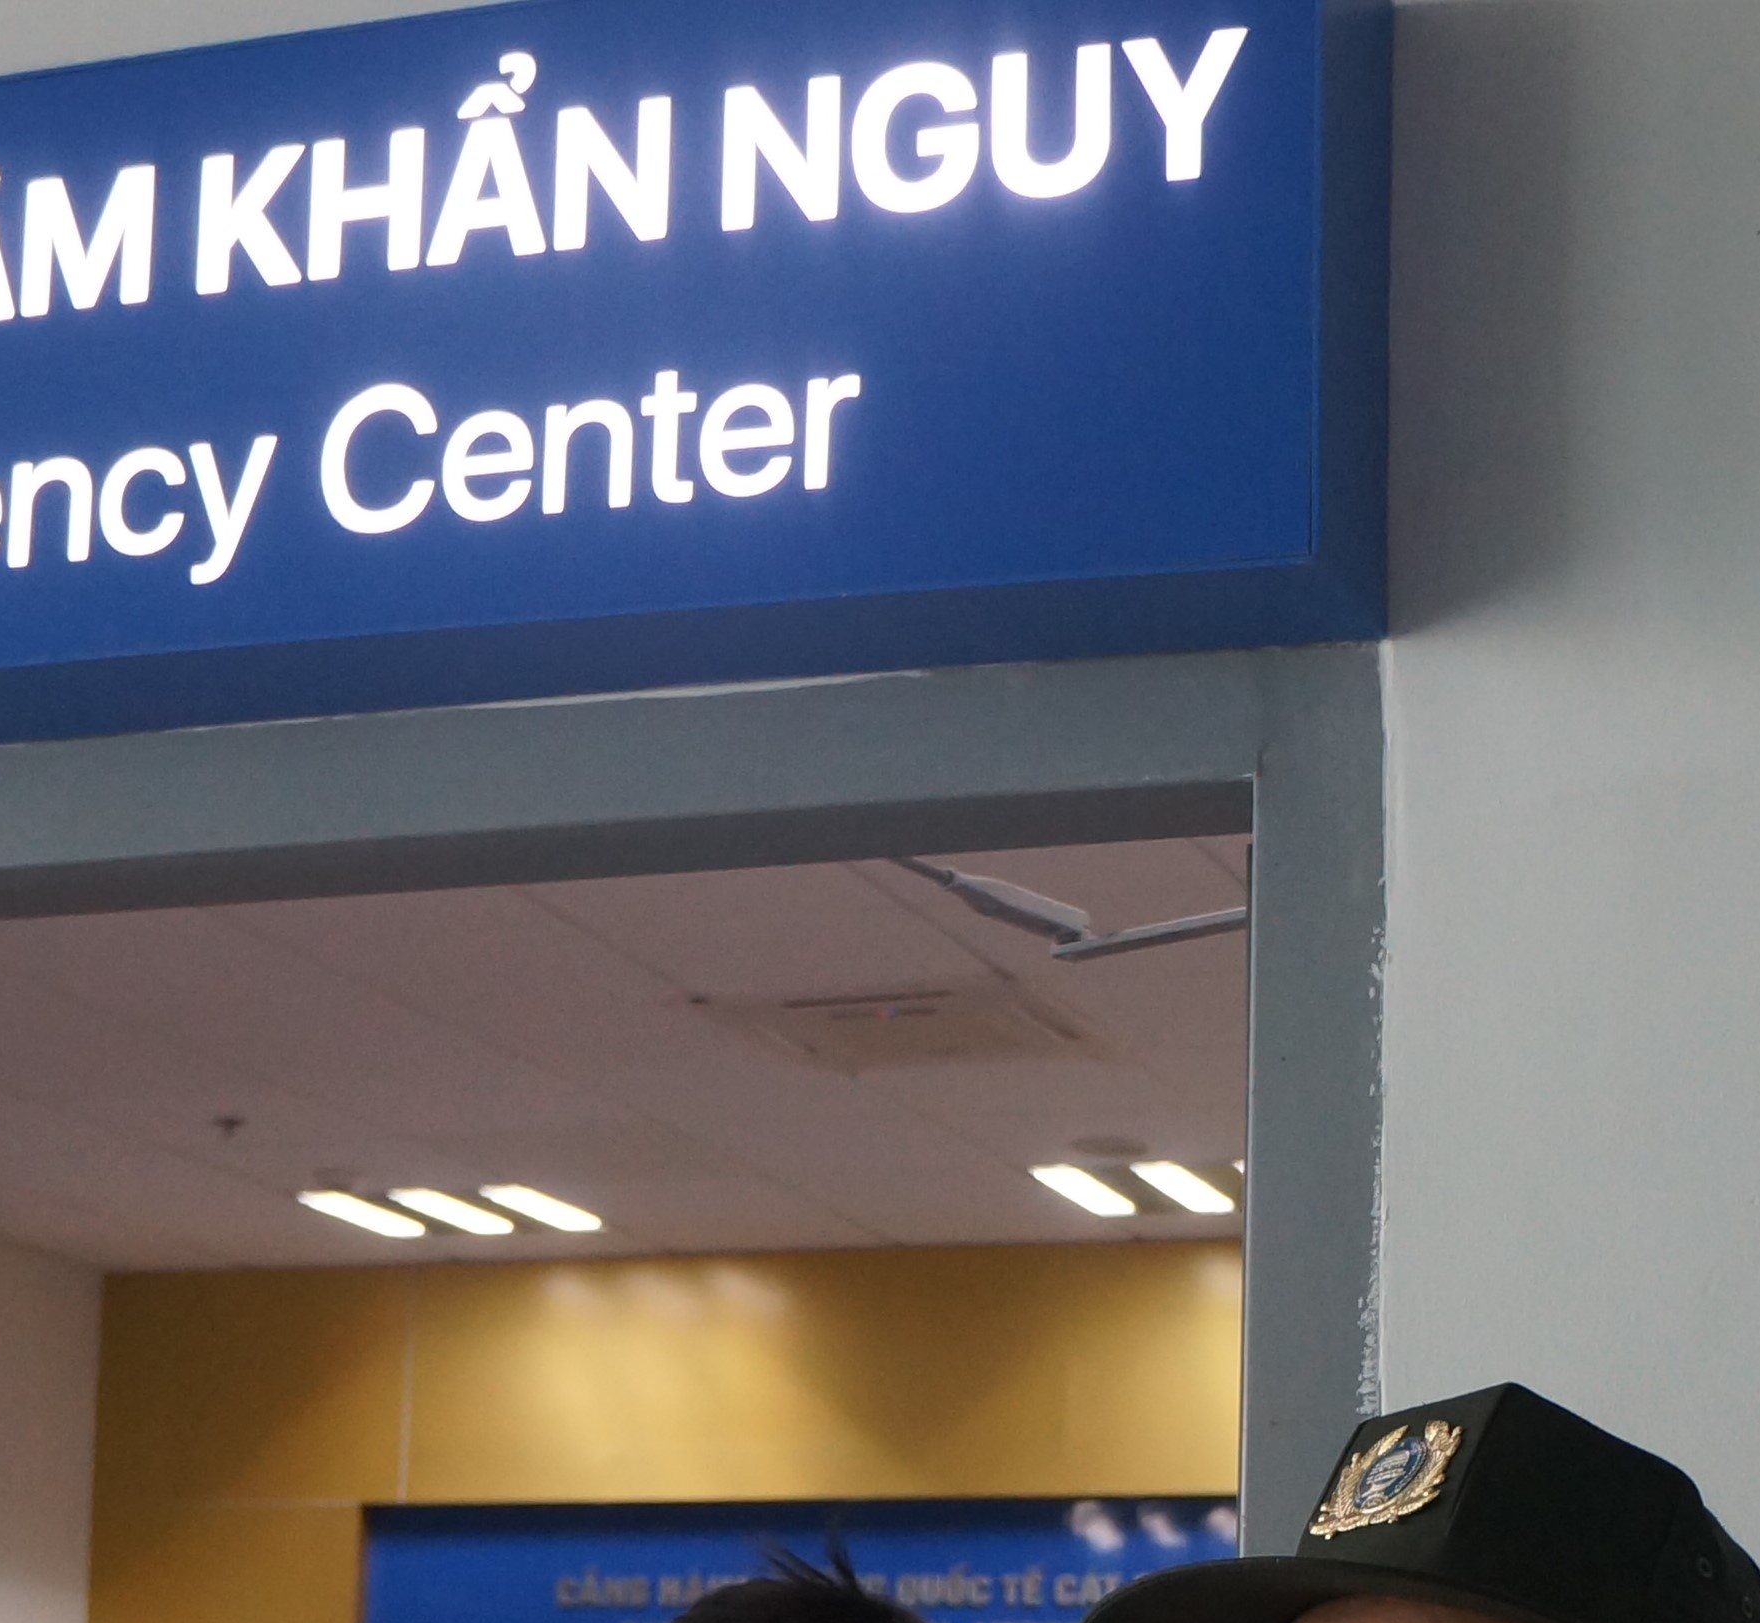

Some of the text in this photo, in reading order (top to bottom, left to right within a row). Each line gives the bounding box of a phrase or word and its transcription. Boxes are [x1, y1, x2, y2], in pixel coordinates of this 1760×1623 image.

[194, 50, 673, 296] KHẨN
[719, 26, 1250, 233] NGUY
[319, 368, 862, 535] Center
